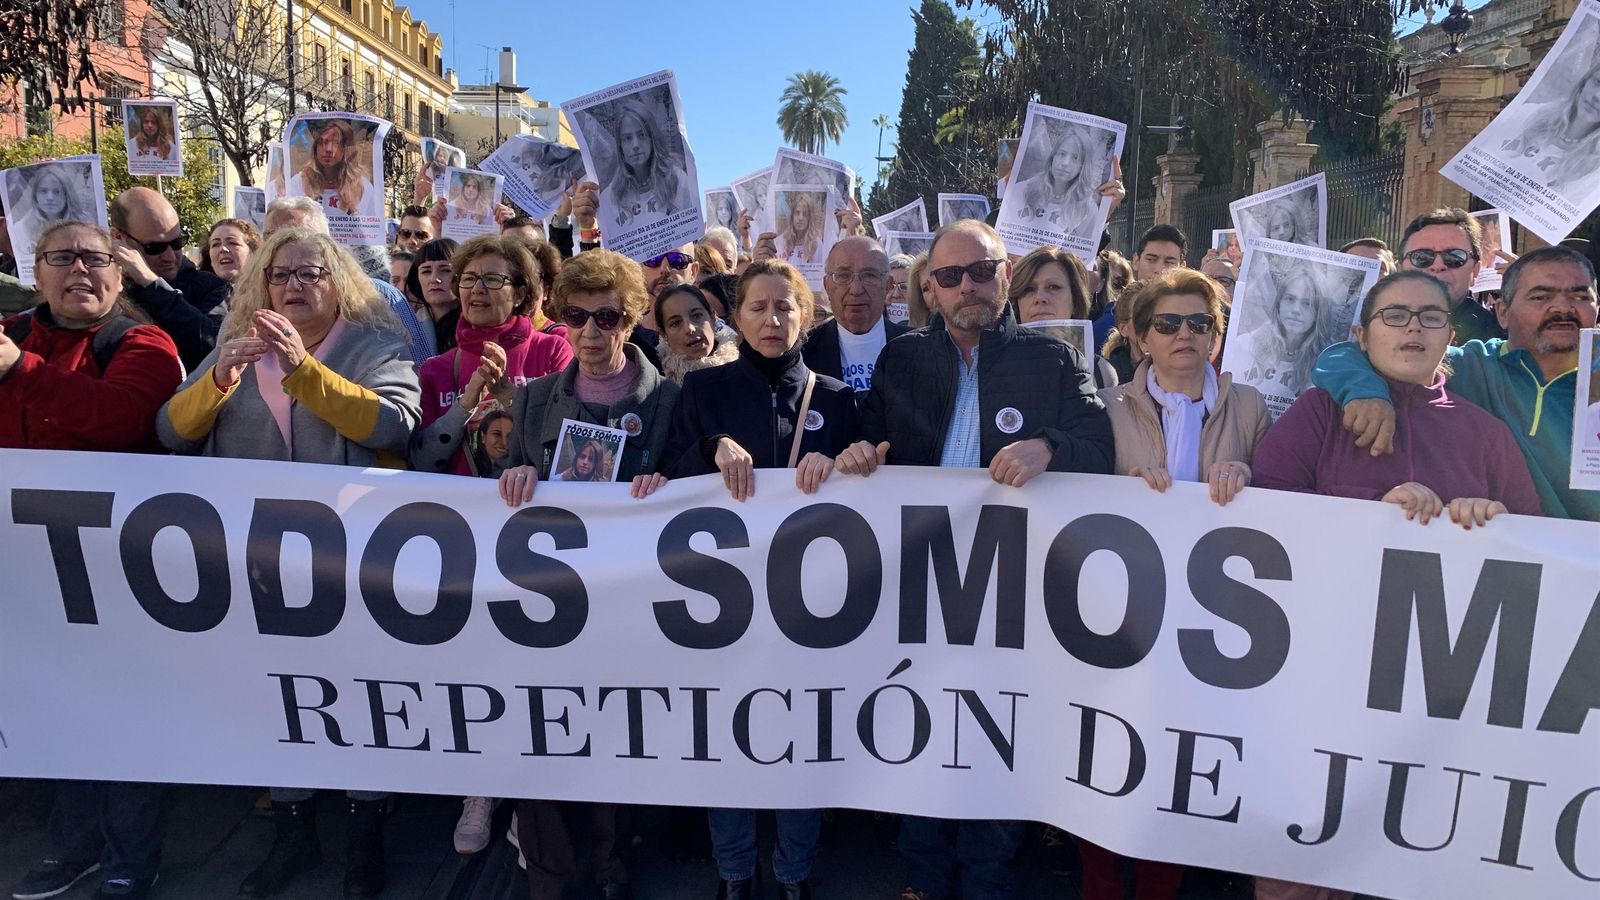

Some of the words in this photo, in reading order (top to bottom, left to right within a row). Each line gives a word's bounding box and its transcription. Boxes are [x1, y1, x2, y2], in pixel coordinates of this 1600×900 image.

[1461, 160, 1478, 172] PLAZA
[1476, 169, 1488, 178] SAN
[1479, 163, 1504, 179] JARDINES
[1508, 180, 1530, 195] MURILLO
[1519, 175, 1528, 183] DE
[1525, 179, 1543, 192] ENERO
[1544, 191, 1556, 201] LAS
[656, 218, 668, 227] ENERO
[685, 207, 697, 216] HORAS
[1049, 232, 1063, 240] ENERO
[1333, 255, 1347, 263] MARTA
[1357, 259, 1377, 269] CASTILLO
[565, 424, 594, 438] TODOS
[593, 430, 623, 443] SOMOS
[11, 488, 588, 648] TODOS
[652, 503, 1293, 690] SOMOS
[267, 658, 1029, 772] REPETICIÓN
[1065, 702, 1244, 824] DE
